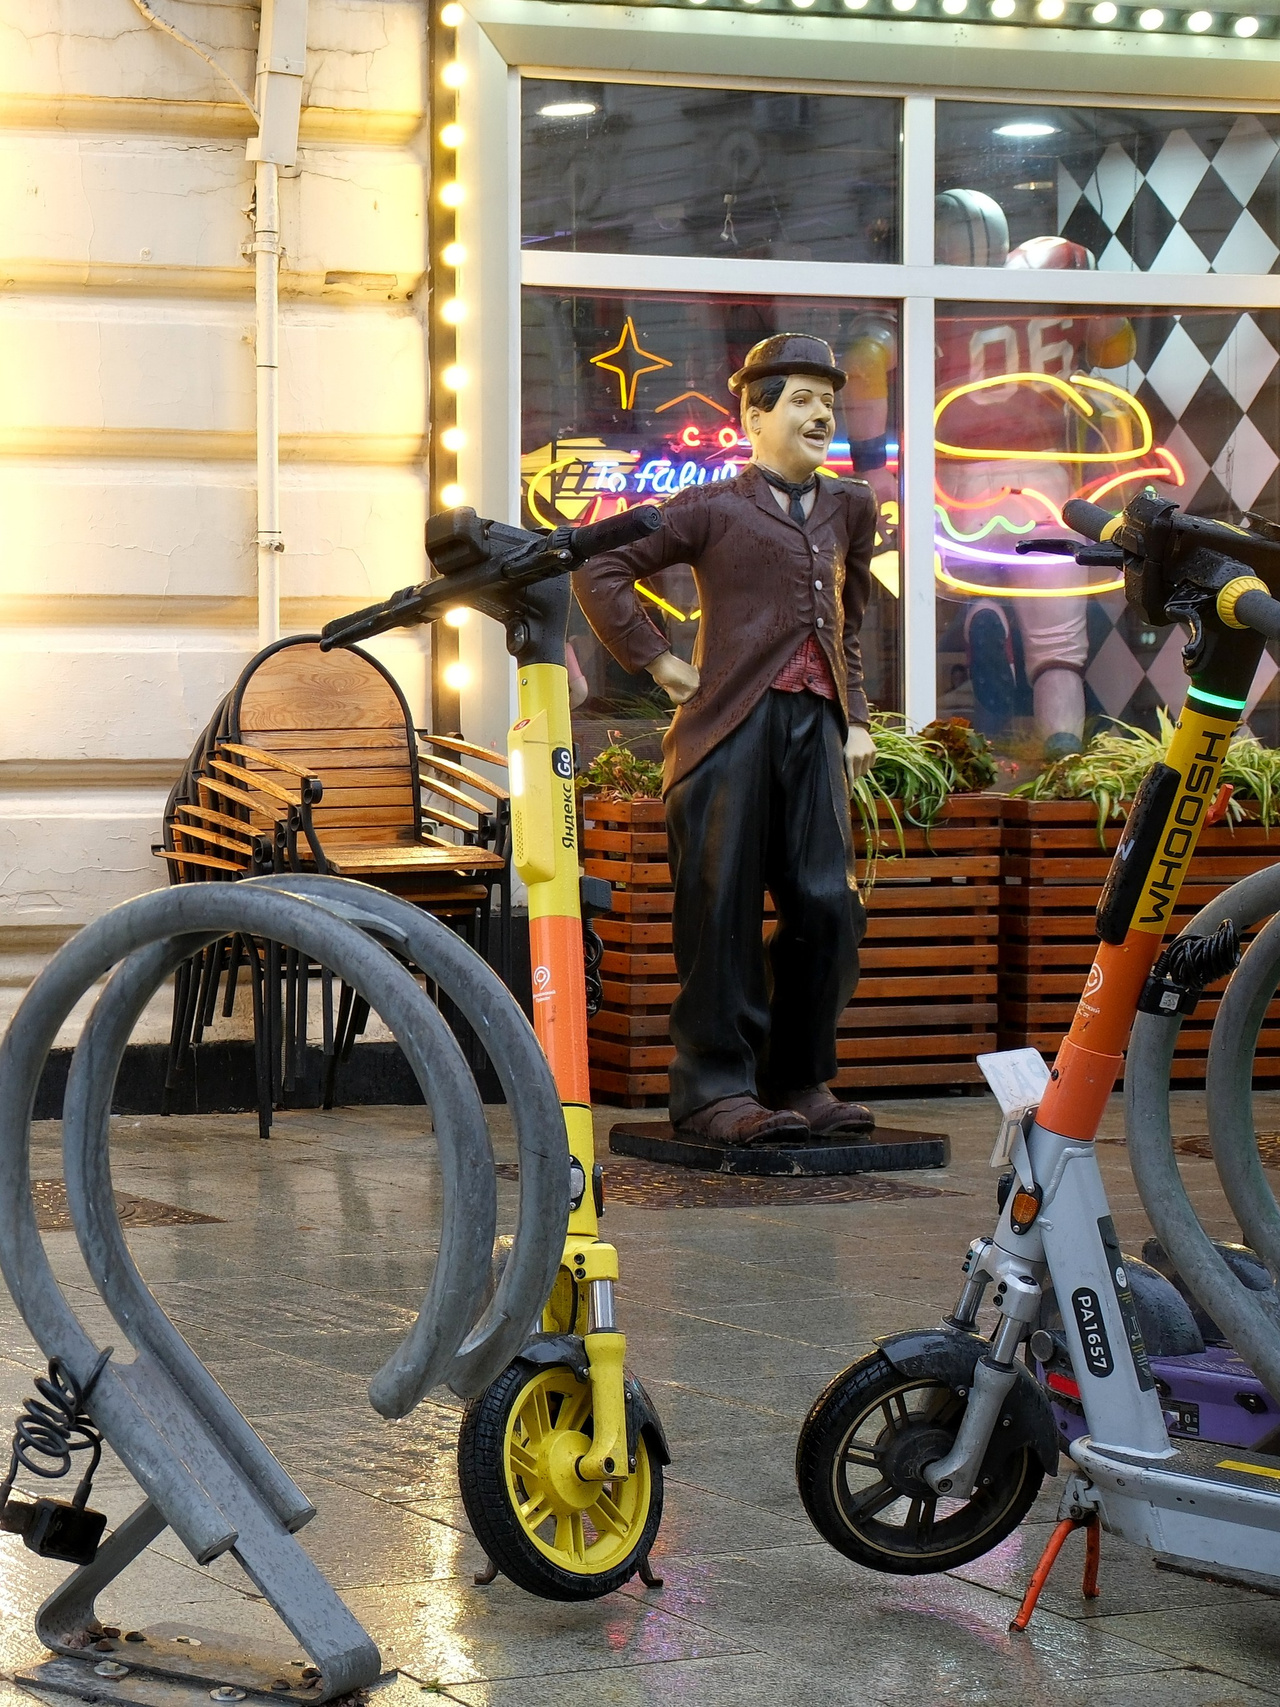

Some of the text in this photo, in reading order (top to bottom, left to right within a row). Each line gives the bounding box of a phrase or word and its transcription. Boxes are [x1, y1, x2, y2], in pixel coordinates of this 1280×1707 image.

[592, 461, 627, 493] To
[557, 751, 575, 849] Яндекс Go
[1139, 730, 1226, 924] WHOOSH
[1077, 1295, 1108, 1369] PA1657
